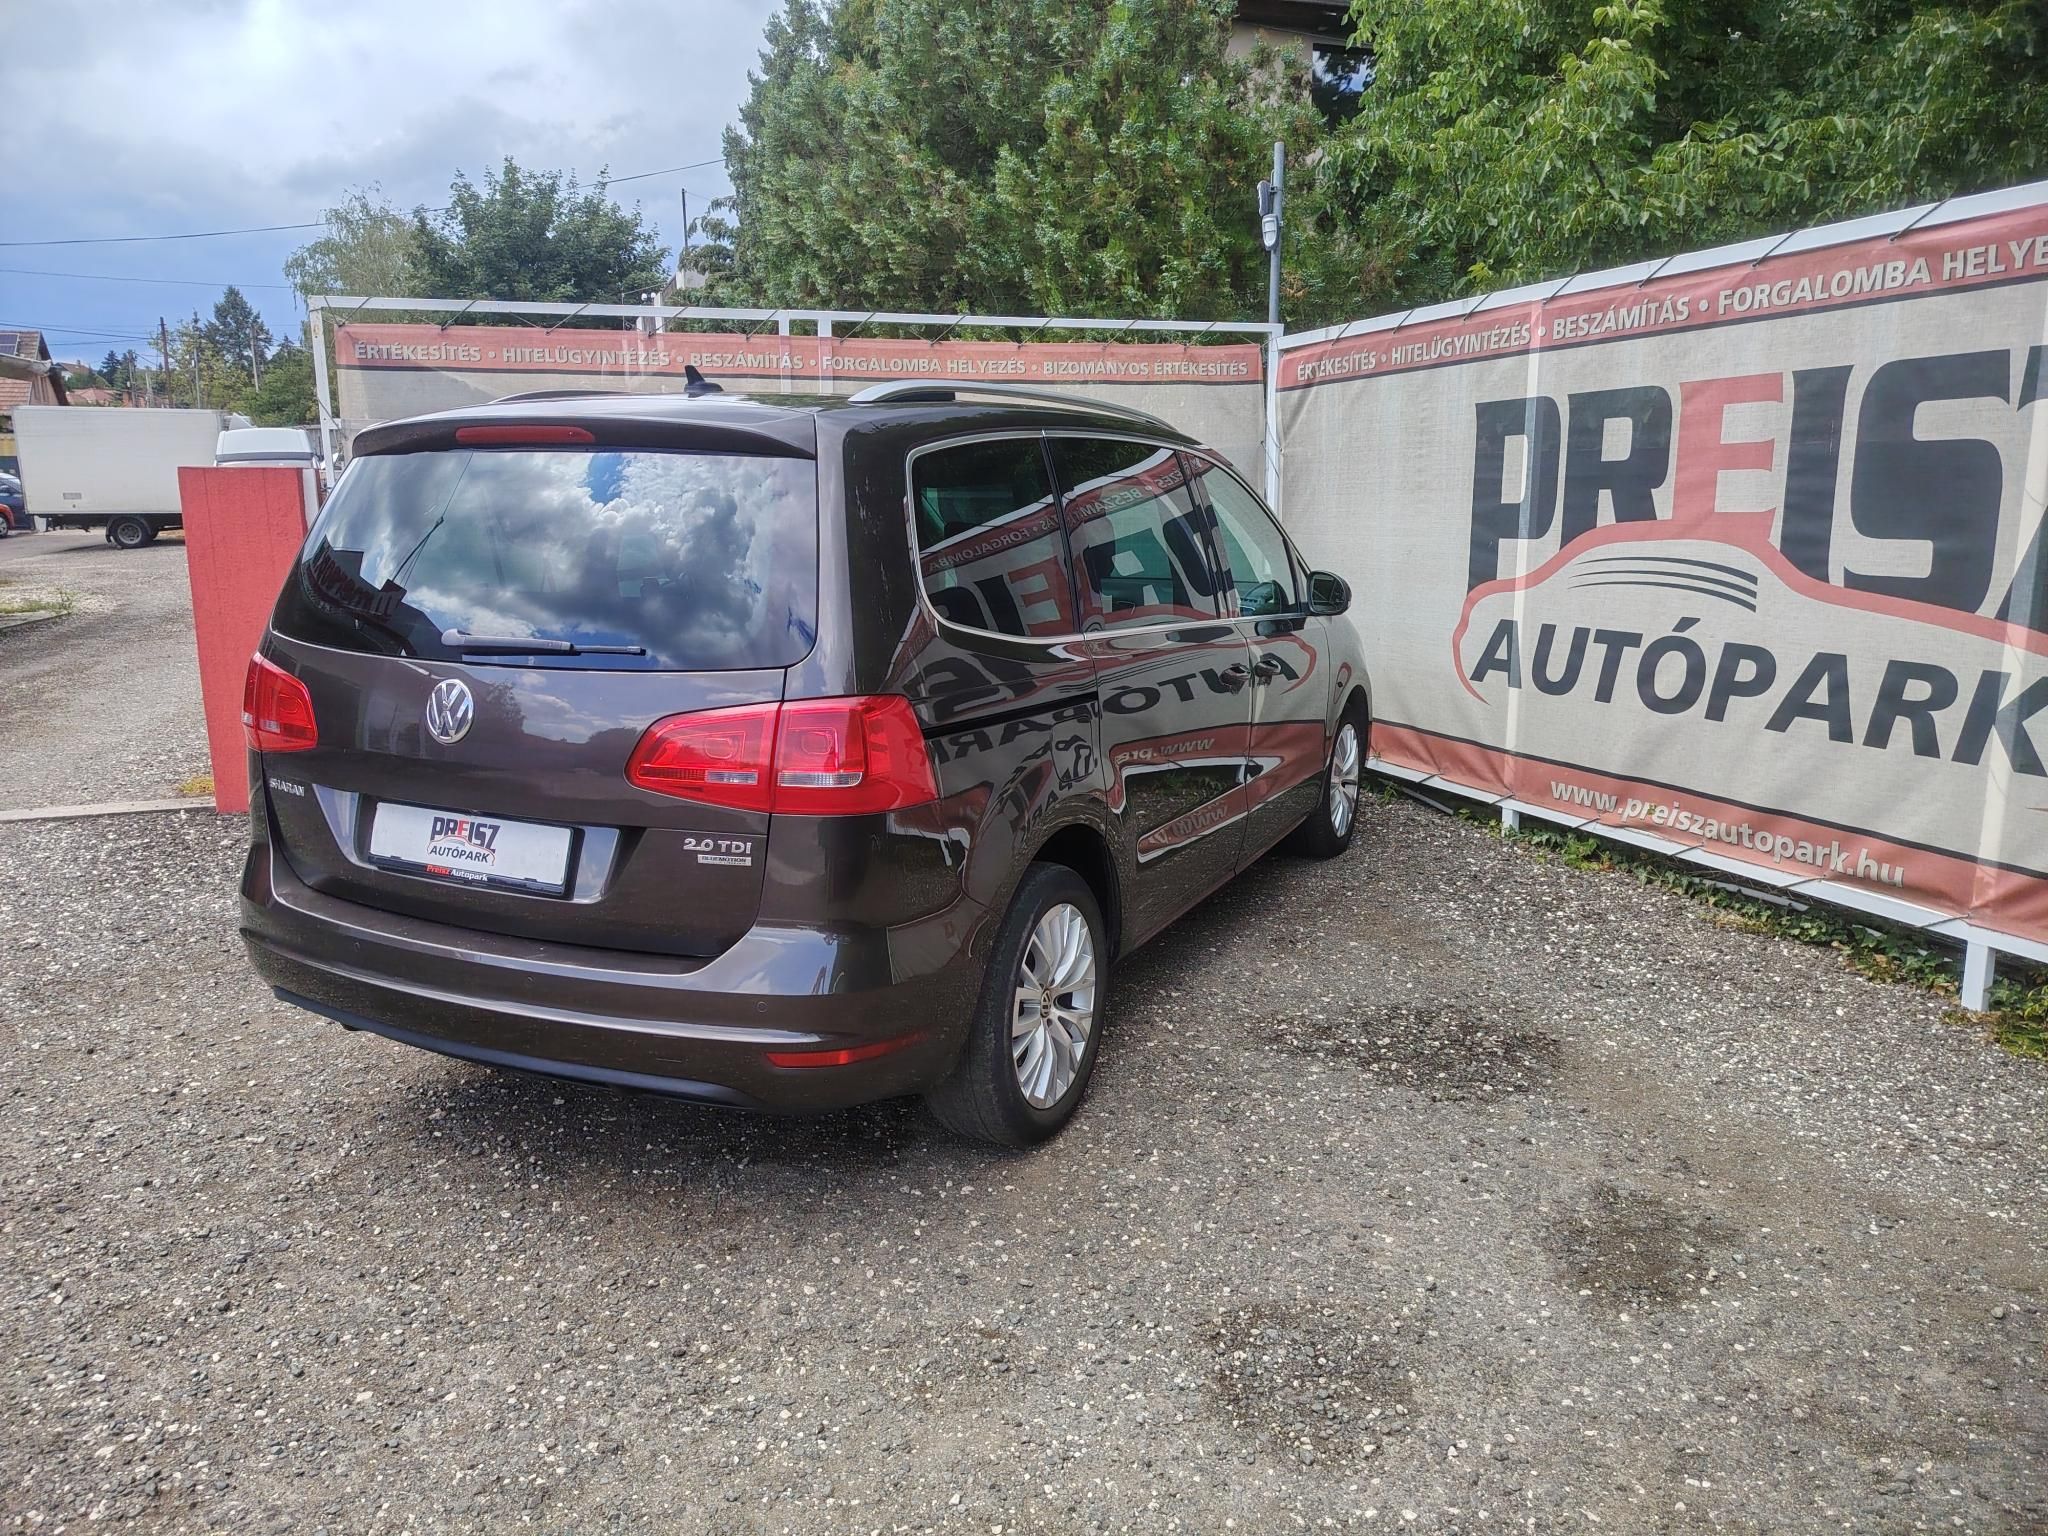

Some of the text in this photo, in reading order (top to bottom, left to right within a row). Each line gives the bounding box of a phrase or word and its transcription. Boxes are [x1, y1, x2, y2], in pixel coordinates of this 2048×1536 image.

[1297, 348, 1376, 381] ÉRTÉKESÍTÉS
[1391, 320, 1531, 366] HITELÜGYINTÉZÉS
[1552, 294, 1690, 340] BESZÁMÍTÁS
[1718, 256, 1931, 315] FORGALOMBA
[354, 341, 1248, 376] ÉRTÉKESÍTÉS HITELÜGYINTÉZÉS BESZÁMÍTÁS FORGALOMBA HELYEZÉS BIZOMÁNYOS ÉRTÉKESÍTÉS
[1467, 345, 2048, 632] PREIS
[1470, 617, 2048, 778] AUTÓPARK
[430, 816, 501, 854] PREISZ
[717, 840, 753, 855] TDI
[1550, 780, 1905, 888] www.preiszautopark.hu
[429, 845, 490, 863] AUTÓPARK
[450, 868, 488, 882] Autopark
